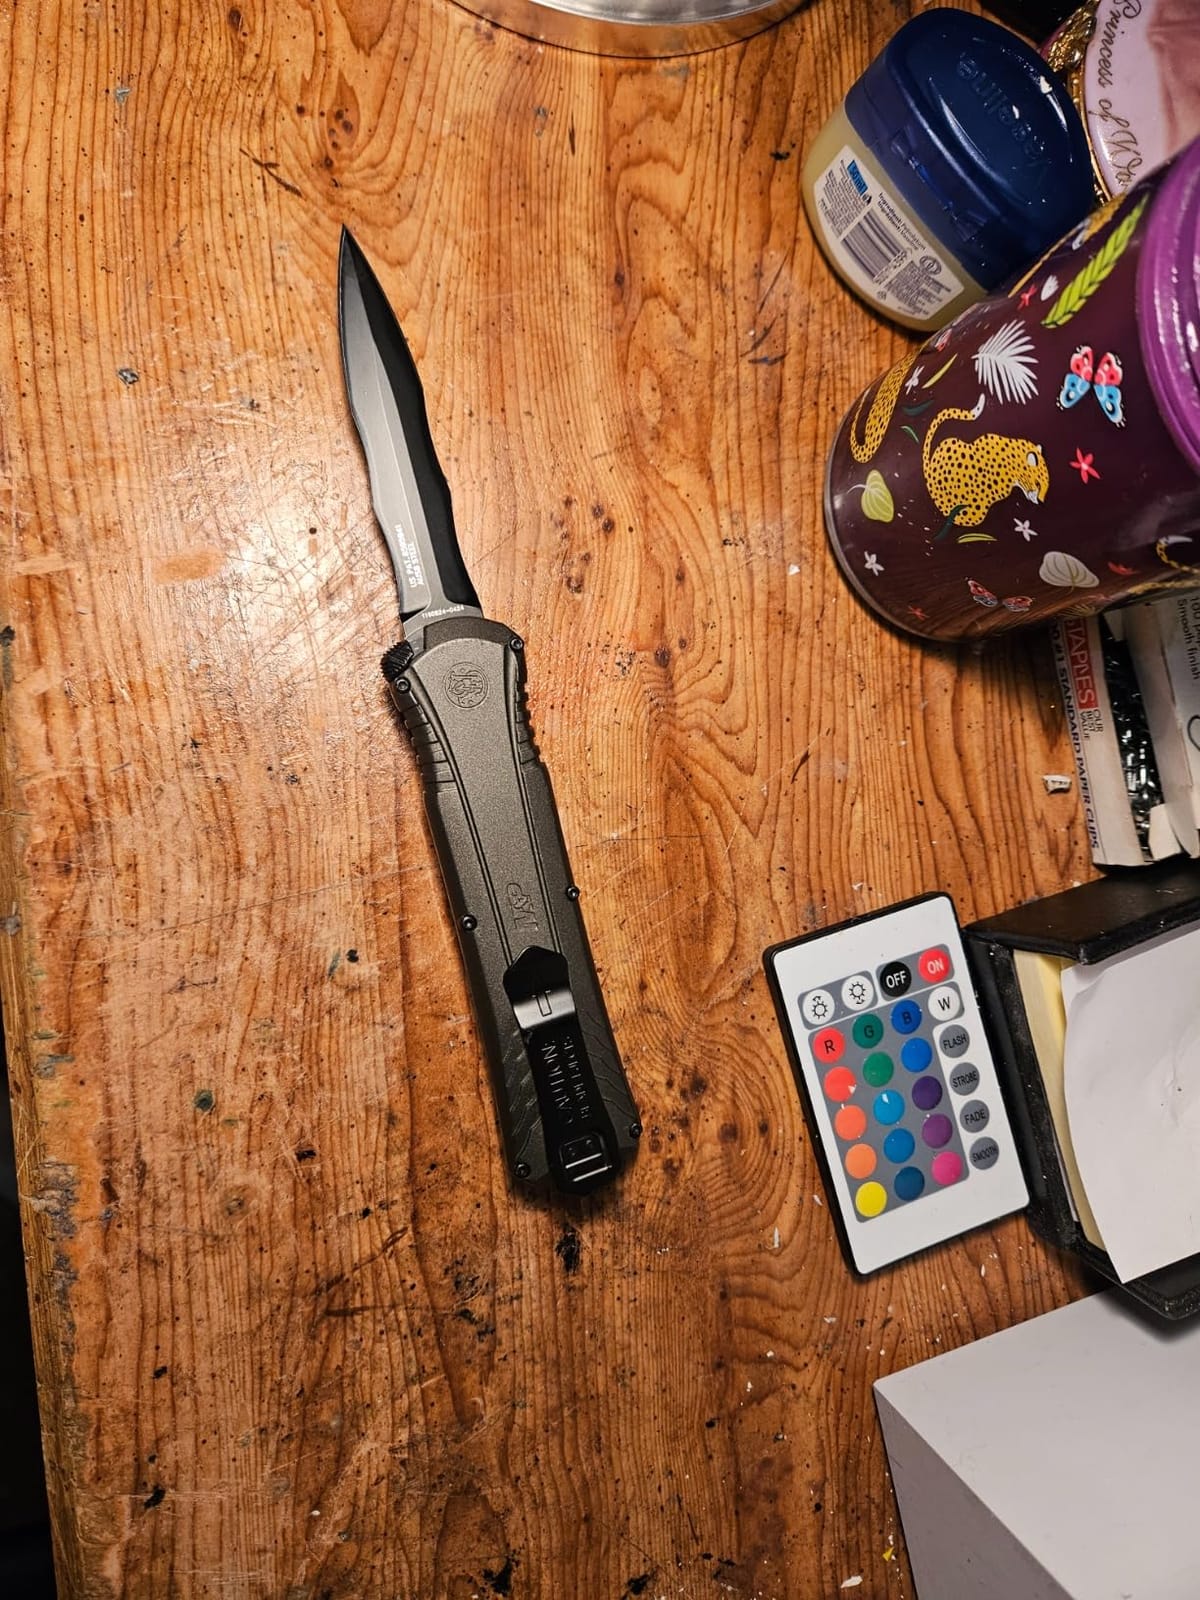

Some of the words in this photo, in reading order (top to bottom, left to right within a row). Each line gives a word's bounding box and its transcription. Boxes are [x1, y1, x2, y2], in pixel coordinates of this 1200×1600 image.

[1088, 99, 1130, 128] of
[1177, 598, 1194, 644] Smooth
[1187, 647, 1200, 680] finish
[1080, 710, 1089, 740] VALUE
[1087, 710, 1095, 732] BEST
[1094, 709, 1103, 732] OUR
[1060, 668, 1081, 753] STANDARD
[1077, 756, 1091, 804] PAPER
[1085, 808, 1099, 849] CLIPS
[927, 958, 944, 976] ON
[885, 971, 907, 989] OFF
[938, 997, 951, 1011] W
[902, 1011, 912, 1025] B
[863, 1024, 875, 1039] G
[824, 1039, 834, 1054] R
[942, 1032, 967, 1050] FLASH
[952, 1069, 979, 1088] STROBE
[963, 1108, 986, 1125] FADE
[972, 1146, 998, 1163] SMOOTH
